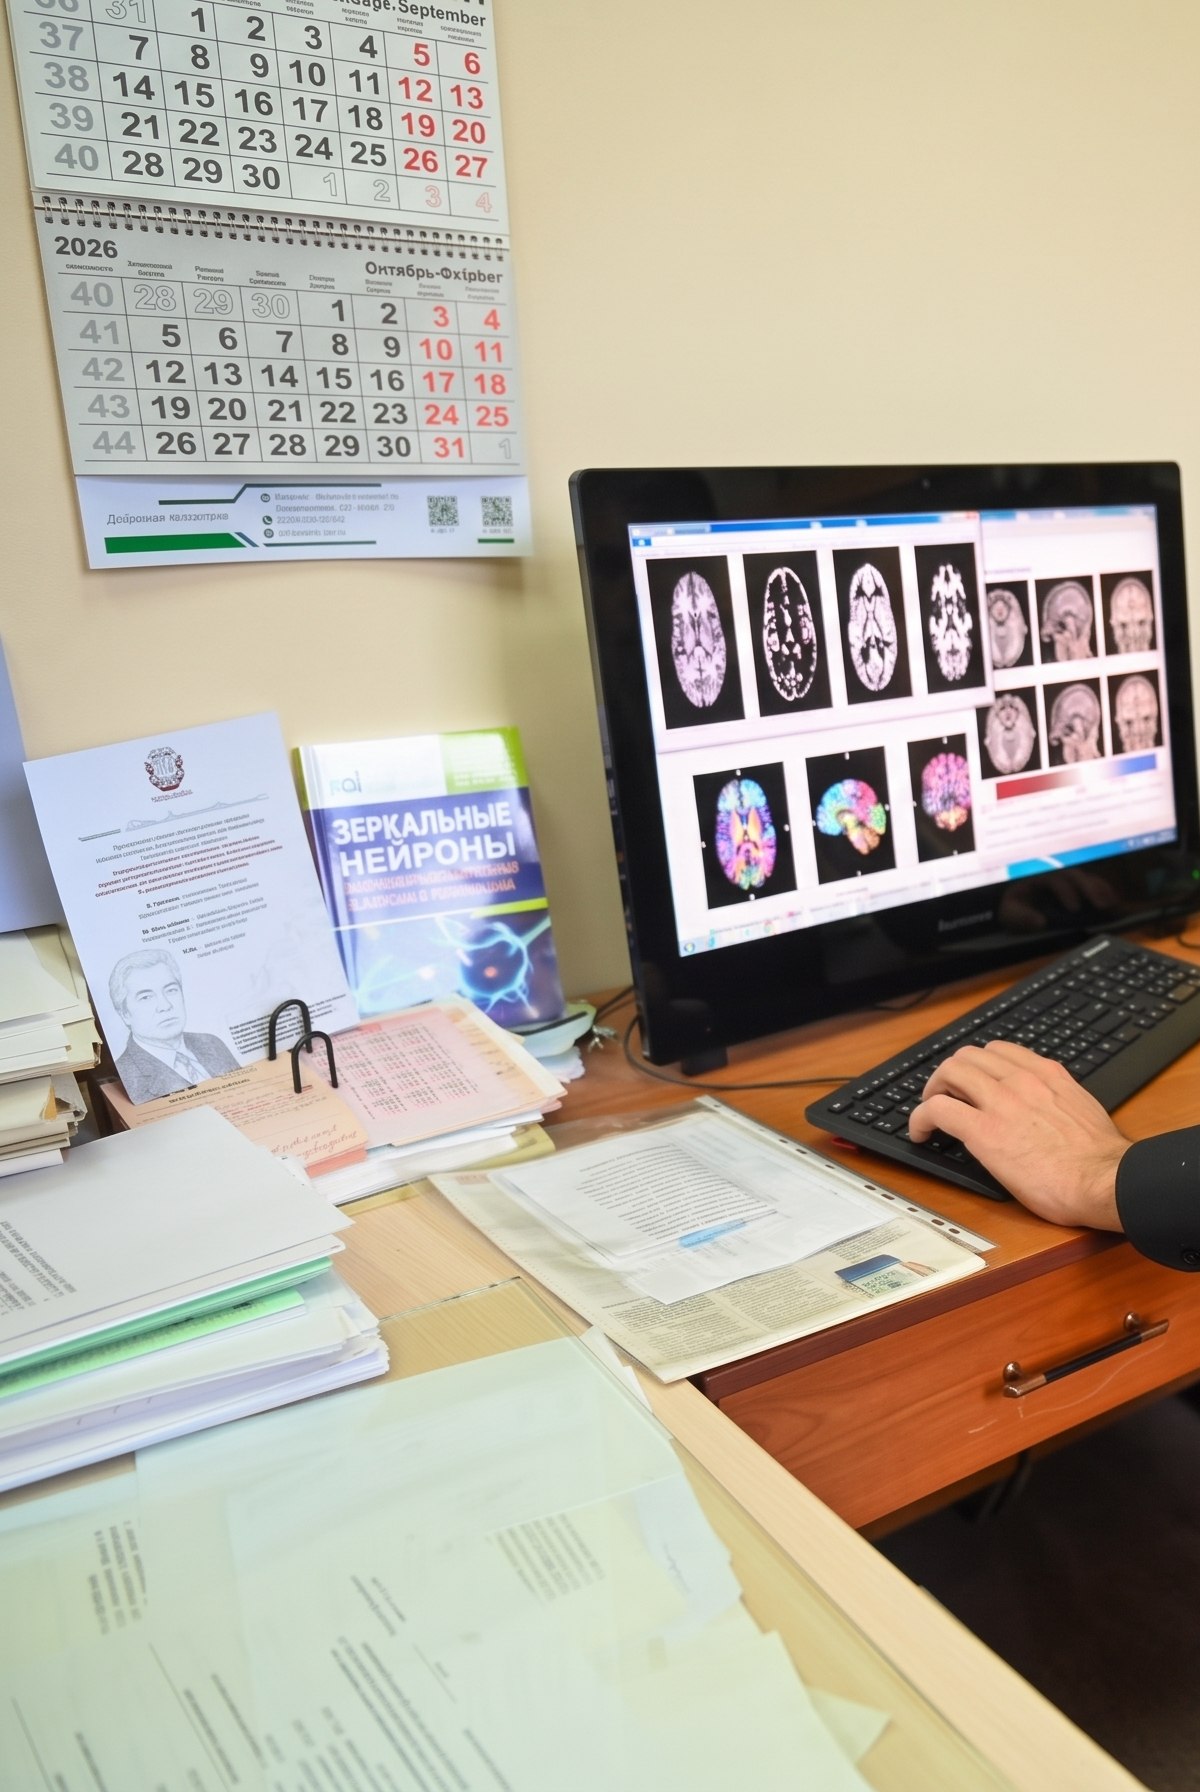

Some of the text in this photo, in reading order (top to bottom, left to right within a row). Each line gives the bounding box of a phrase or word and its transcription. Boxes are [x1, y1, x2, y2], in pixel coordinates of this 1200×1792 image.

[191, 8, 205, 32] 1
[247, 16, 265, 41] 2
[305, 26, 322, 49] 3
[359, 35, 377, 58] 4
[414, 43, 430, 66] 5
[465, 52, 480, 74] 6
[39, 22, 483, 109] 37 7 8 9 10 11 12 13
[44, 62, 485, 144] 38 14 15 16 17 18 19 20
[49, 103, 487, 178] 39 21 22 23 24 25 26 27
[55, 143, 492, 213] 40 28 29 30 1 2 3 4
[54, 236, 118, 259] 2026
[71, 282, 500, 330] 40 28 29 30 1 2 3 4
[80, 320, 502, 362] 41 5 6 7 8 9 10 11
[82, 357, 506, 395] 42 12 13 14 15 16 17 18
[88, 394, 509, 427] 43 19 20 21 22 23 24 25
[93, 431, 512, 459] 44 26 27 28 29 30 31 1
[333, 802, 512, 845] ЗЕРКАЛЬНЫЕ
[339, 832, 516, 877] НЕЙРОНЫ
